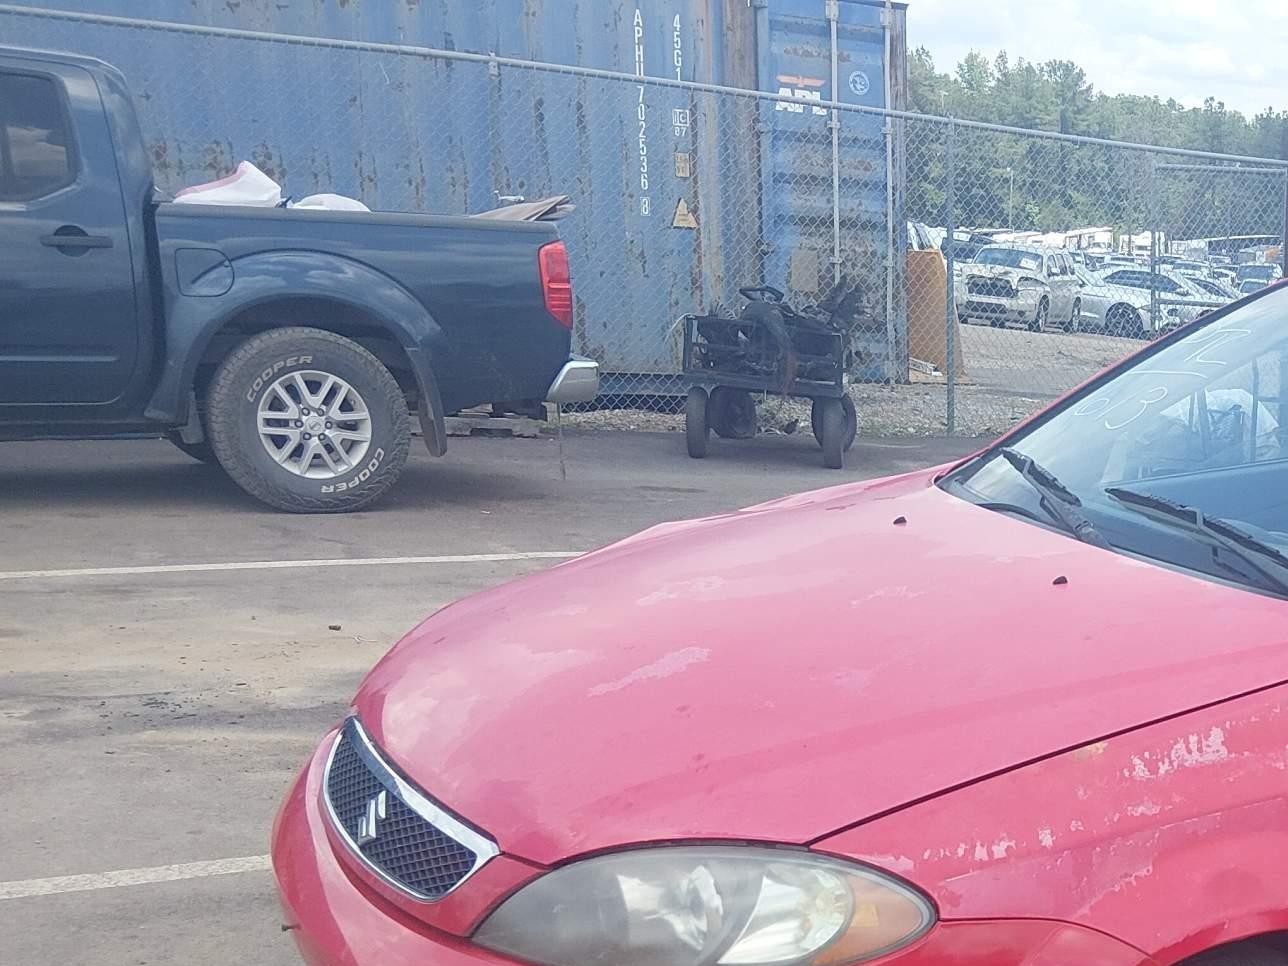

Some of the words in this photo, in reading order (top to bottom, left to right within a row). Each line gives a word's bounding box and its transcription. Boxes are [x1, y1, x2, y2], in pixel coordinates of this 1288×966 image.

[673, 13, 682, 82] 45G1
[246, 355, 314, 403] COOPER
[320, 447, 386, 494] COOPER
